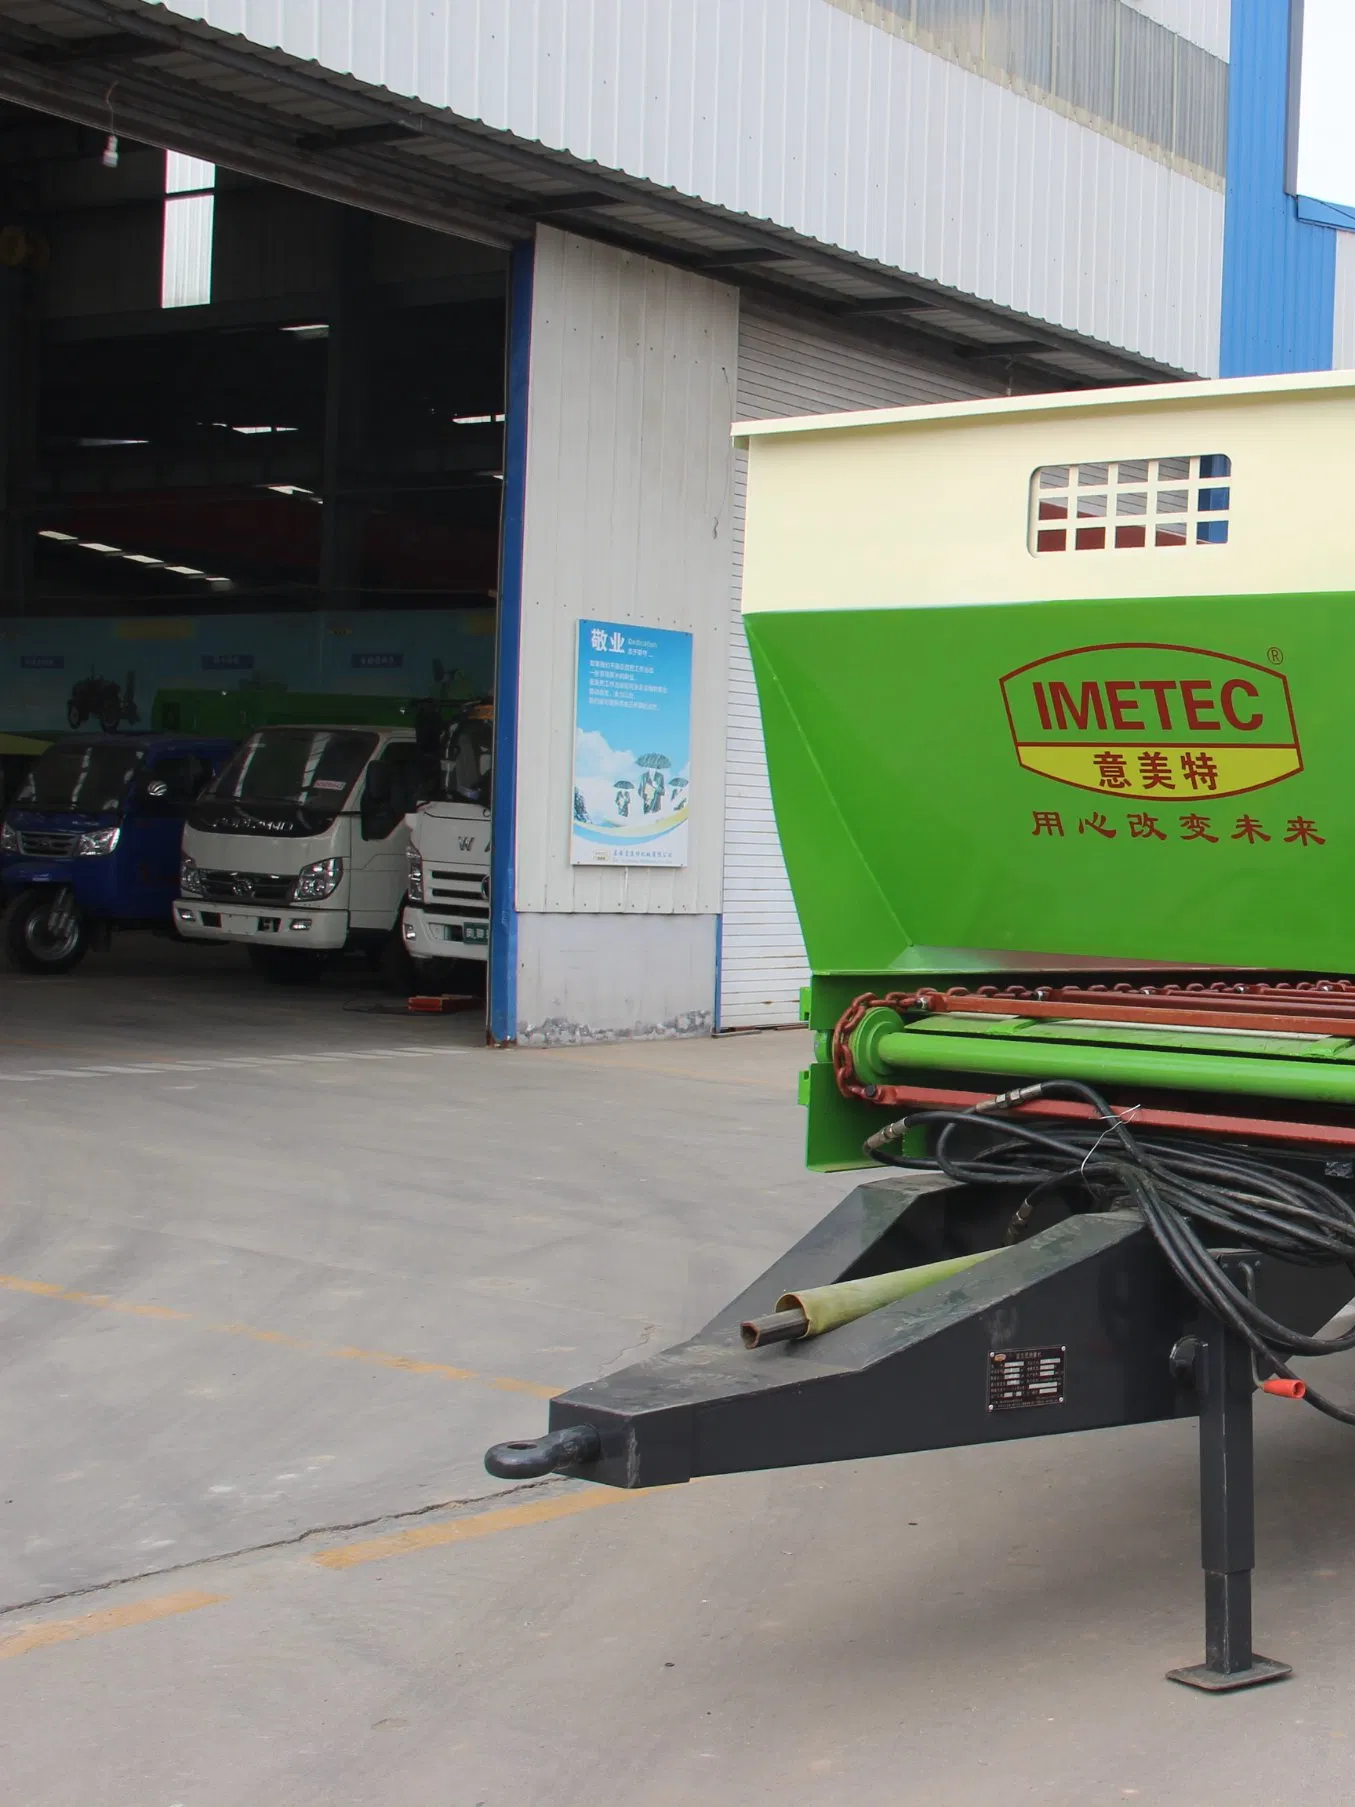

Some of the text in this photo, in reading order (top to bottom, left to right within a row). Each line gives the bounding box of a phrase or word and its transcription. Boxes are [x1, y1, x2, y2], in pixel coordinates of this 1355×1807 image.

[591, 628, 625, 654] 敬业
[1032, 679, 1263, 731] IMETEC
[1093, 751, 1219, 791] 意美特
[1031, 810, 1326, 846] 用心改变未来
